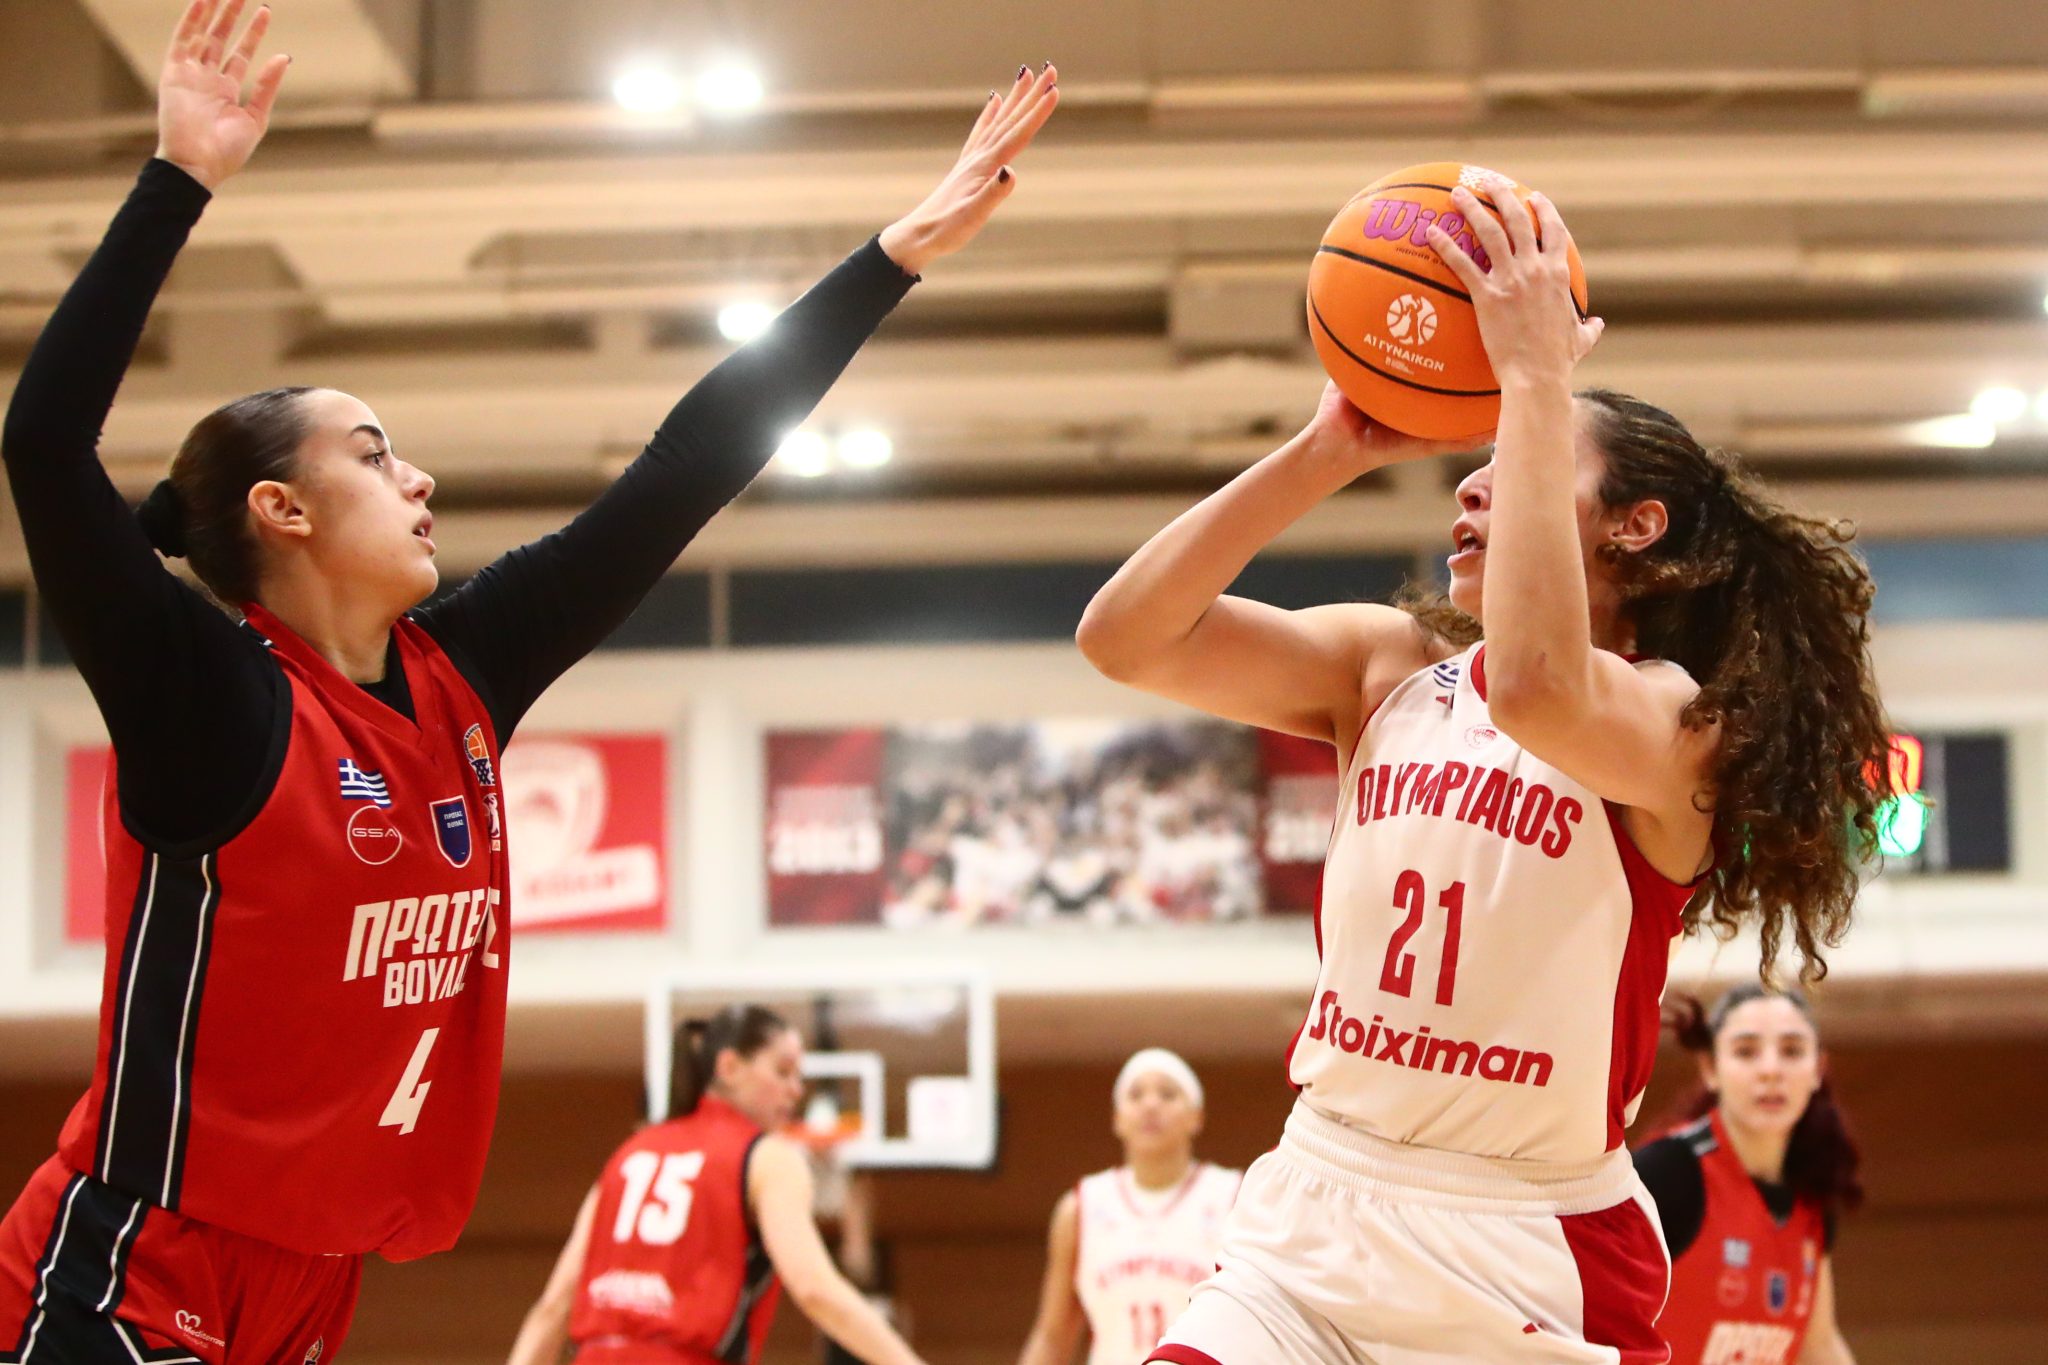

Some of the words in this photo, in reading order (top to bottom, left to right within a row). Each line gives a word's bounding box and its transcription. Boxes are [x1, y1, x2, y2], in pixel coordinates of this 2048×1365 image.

[1363, 199, 1493, 275] Wilso
[1378, 340, 1445, 372] ΓΥΝΑΙΚΩΝ
[352, 828, 398, 838] GSA
[1357, 761, 1583, 859] OLYMPIACOS
[343, 886, 500, 982] ΠΡΩΤΕΣ
[383, 950, 474, 1008] ΒΟΥΛΑ
[1378, 869, 1466, 1007] 21
[377, 1028, 440, 1136] 4
[1309, 989, 1554, 1088] Stoiximan
[612, 1149, 705, 1246] 15
